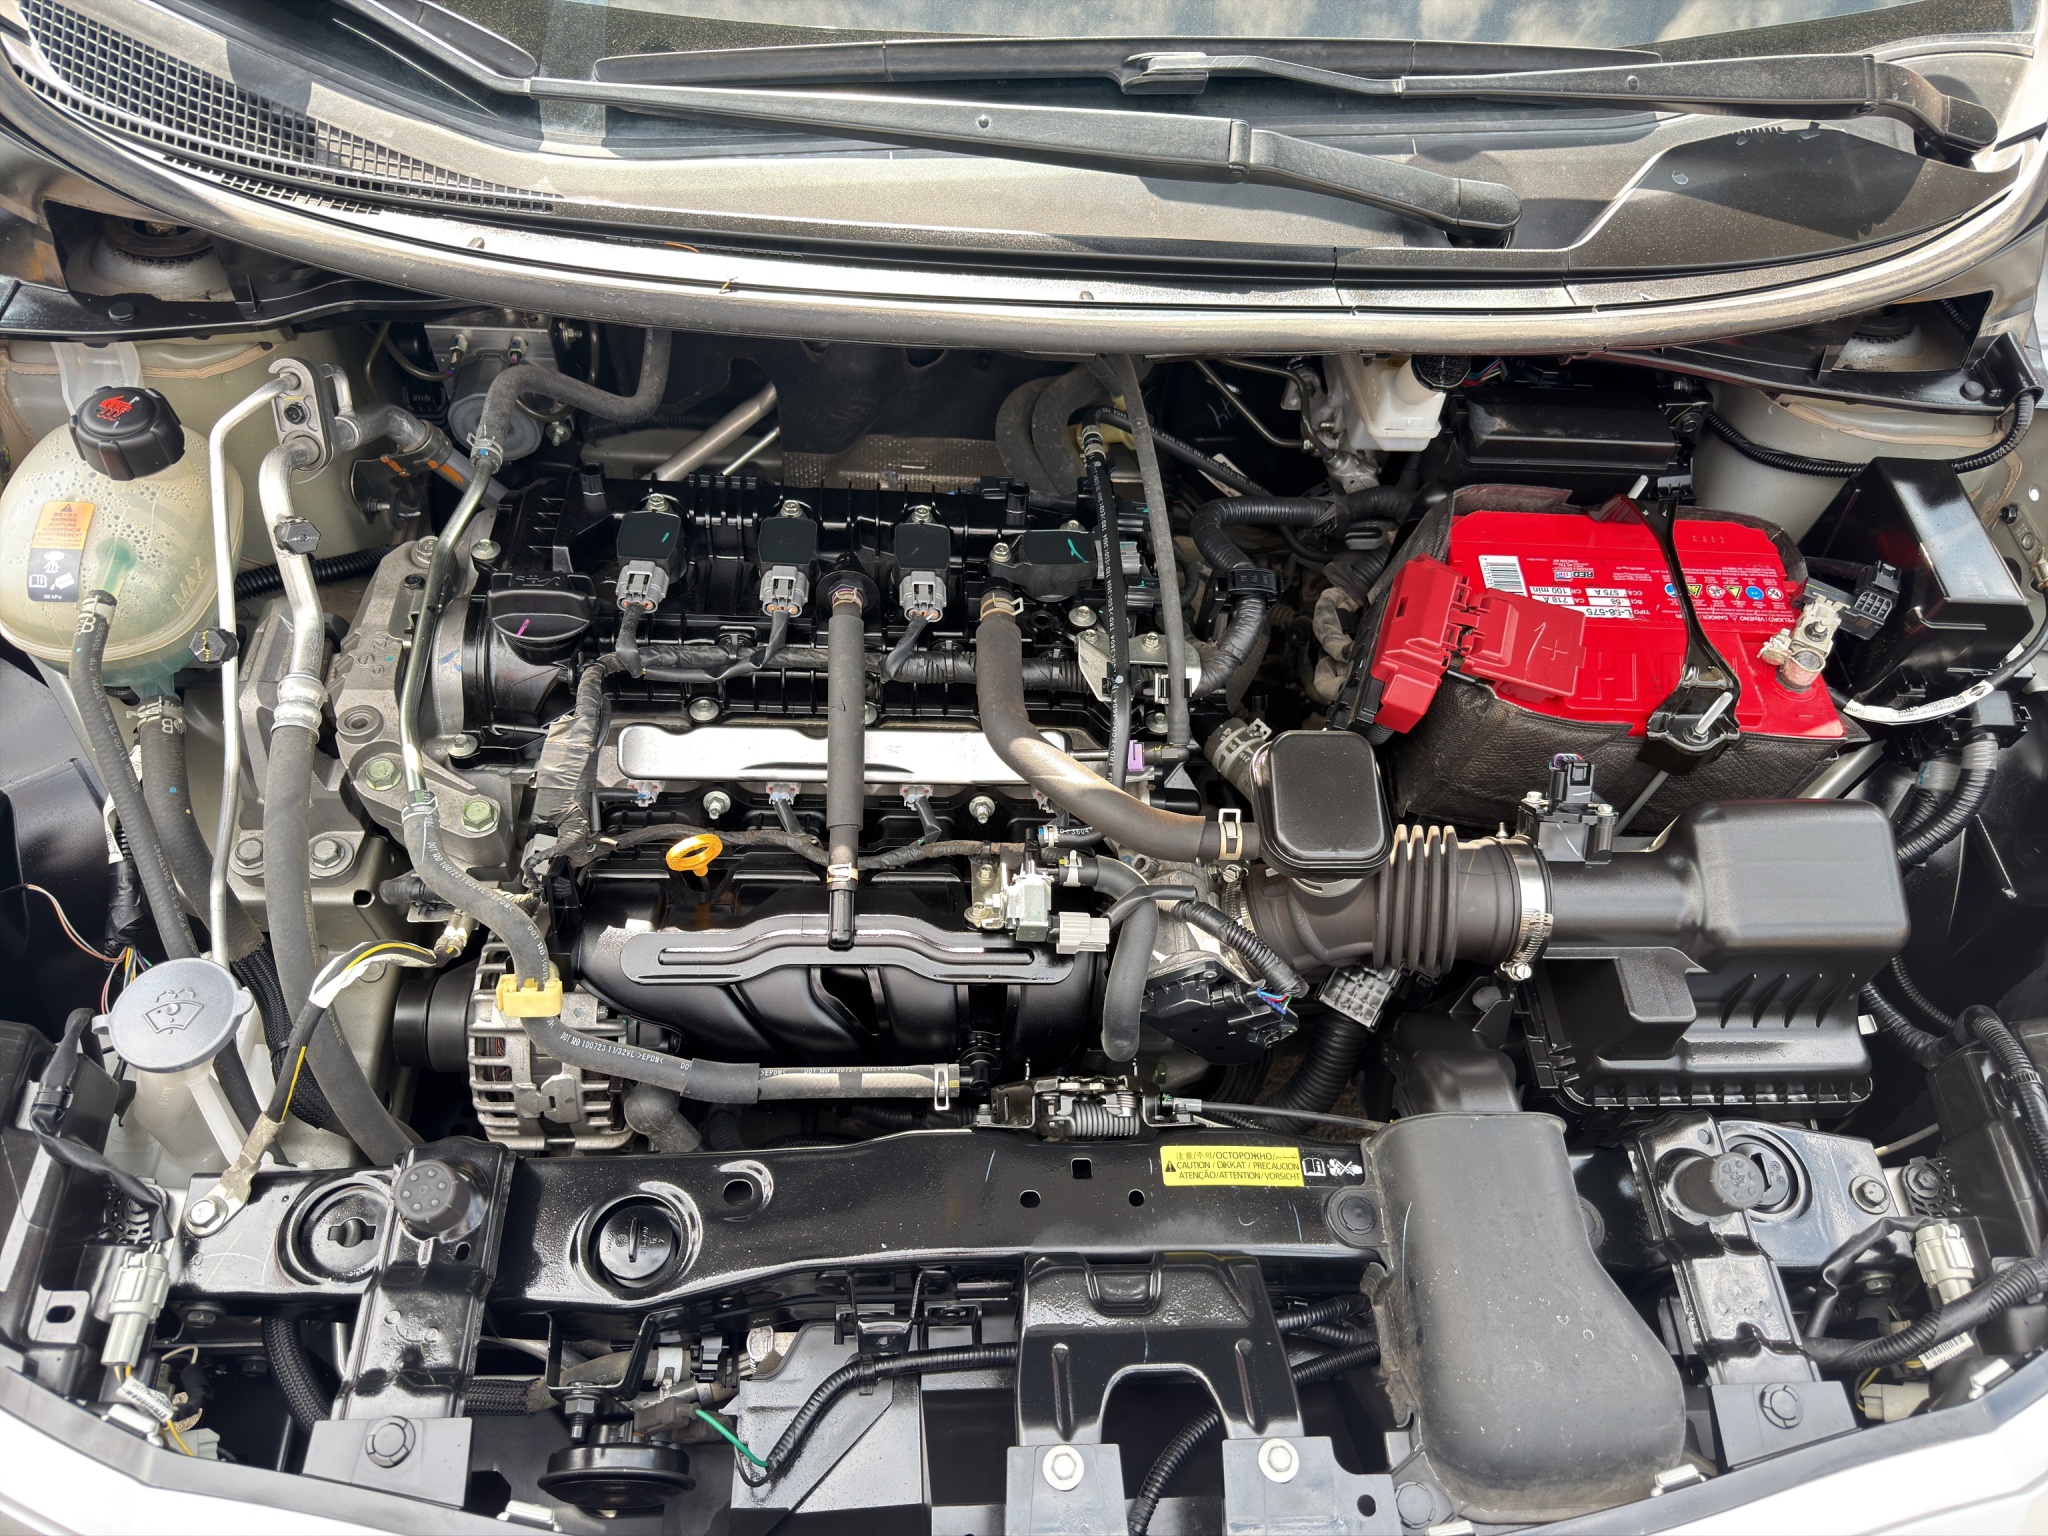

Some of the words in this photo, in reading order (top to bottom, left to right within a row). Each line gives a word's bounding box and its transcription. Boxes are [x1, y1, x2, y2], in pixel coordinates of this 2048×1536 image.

[1532, 586, 1550, 594] min
[581, 1038, 607, 1052] 100723
[1176, 1161, 1211, 1169] CAUTION
